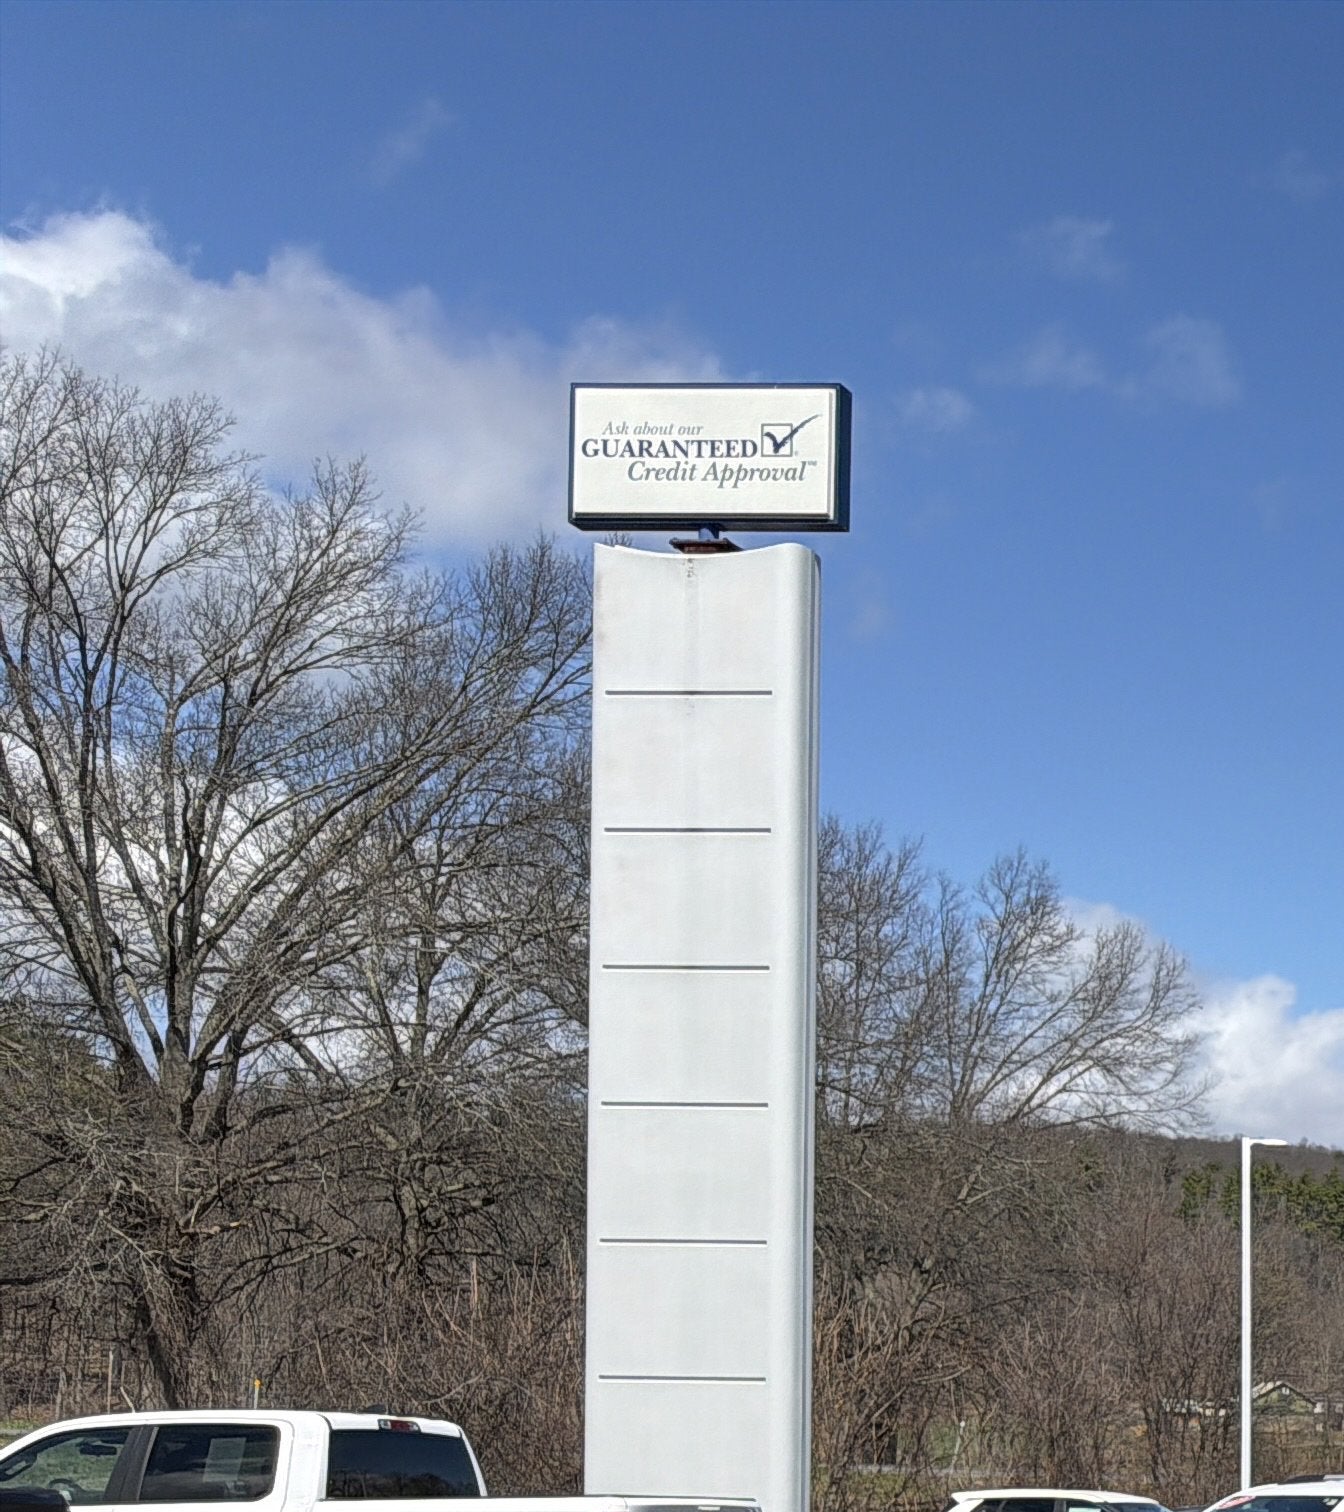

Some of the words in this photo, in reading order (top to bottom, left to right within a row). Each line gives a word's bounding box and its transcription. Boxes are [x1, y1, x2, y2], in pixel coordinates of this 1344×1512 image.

[602, 421, 629, 435] Ask
[633, 421, 675, 435] about
[678, 425, 704, 436] our
[581, 438, 758, 458] GUARANTEED
[628, 460, 699, 481] Credit
[701, 460, 807, 488] Approval
